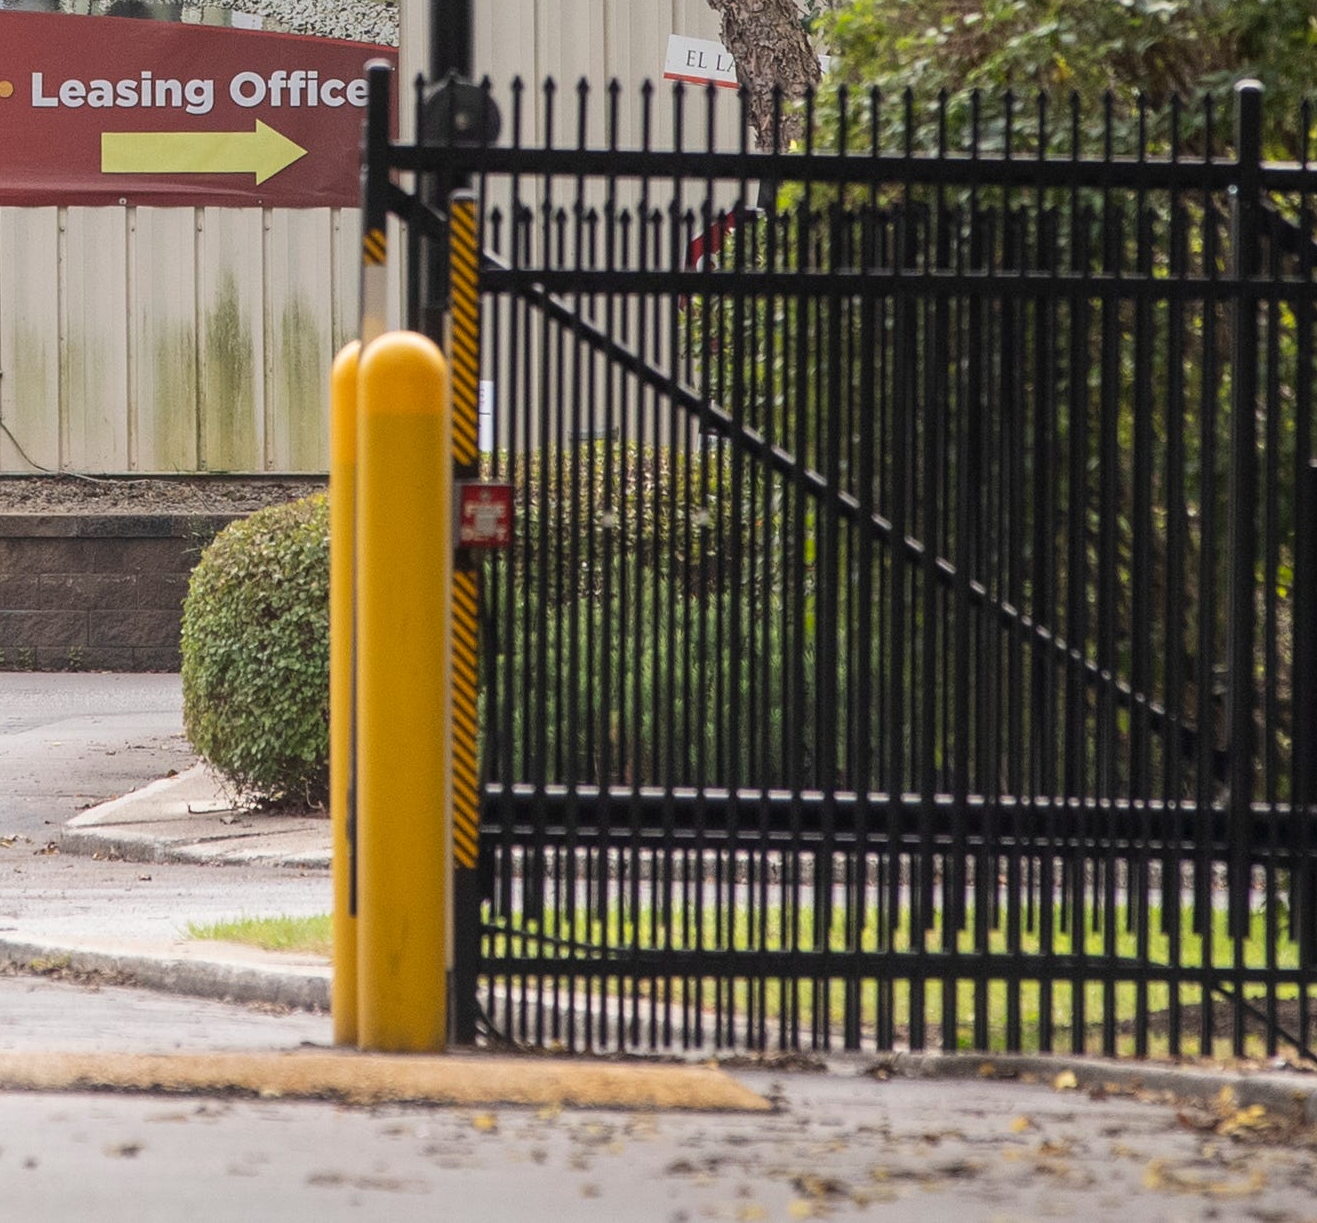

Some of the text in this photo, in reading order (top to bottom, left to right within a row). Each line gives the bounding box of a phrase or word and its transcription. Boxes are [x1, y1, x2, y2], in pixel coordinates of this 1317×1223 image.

[686, 49, 708, 69] EL
[31, 70, 215, 115] Leasing
[229, 70, 370, 108] Office
